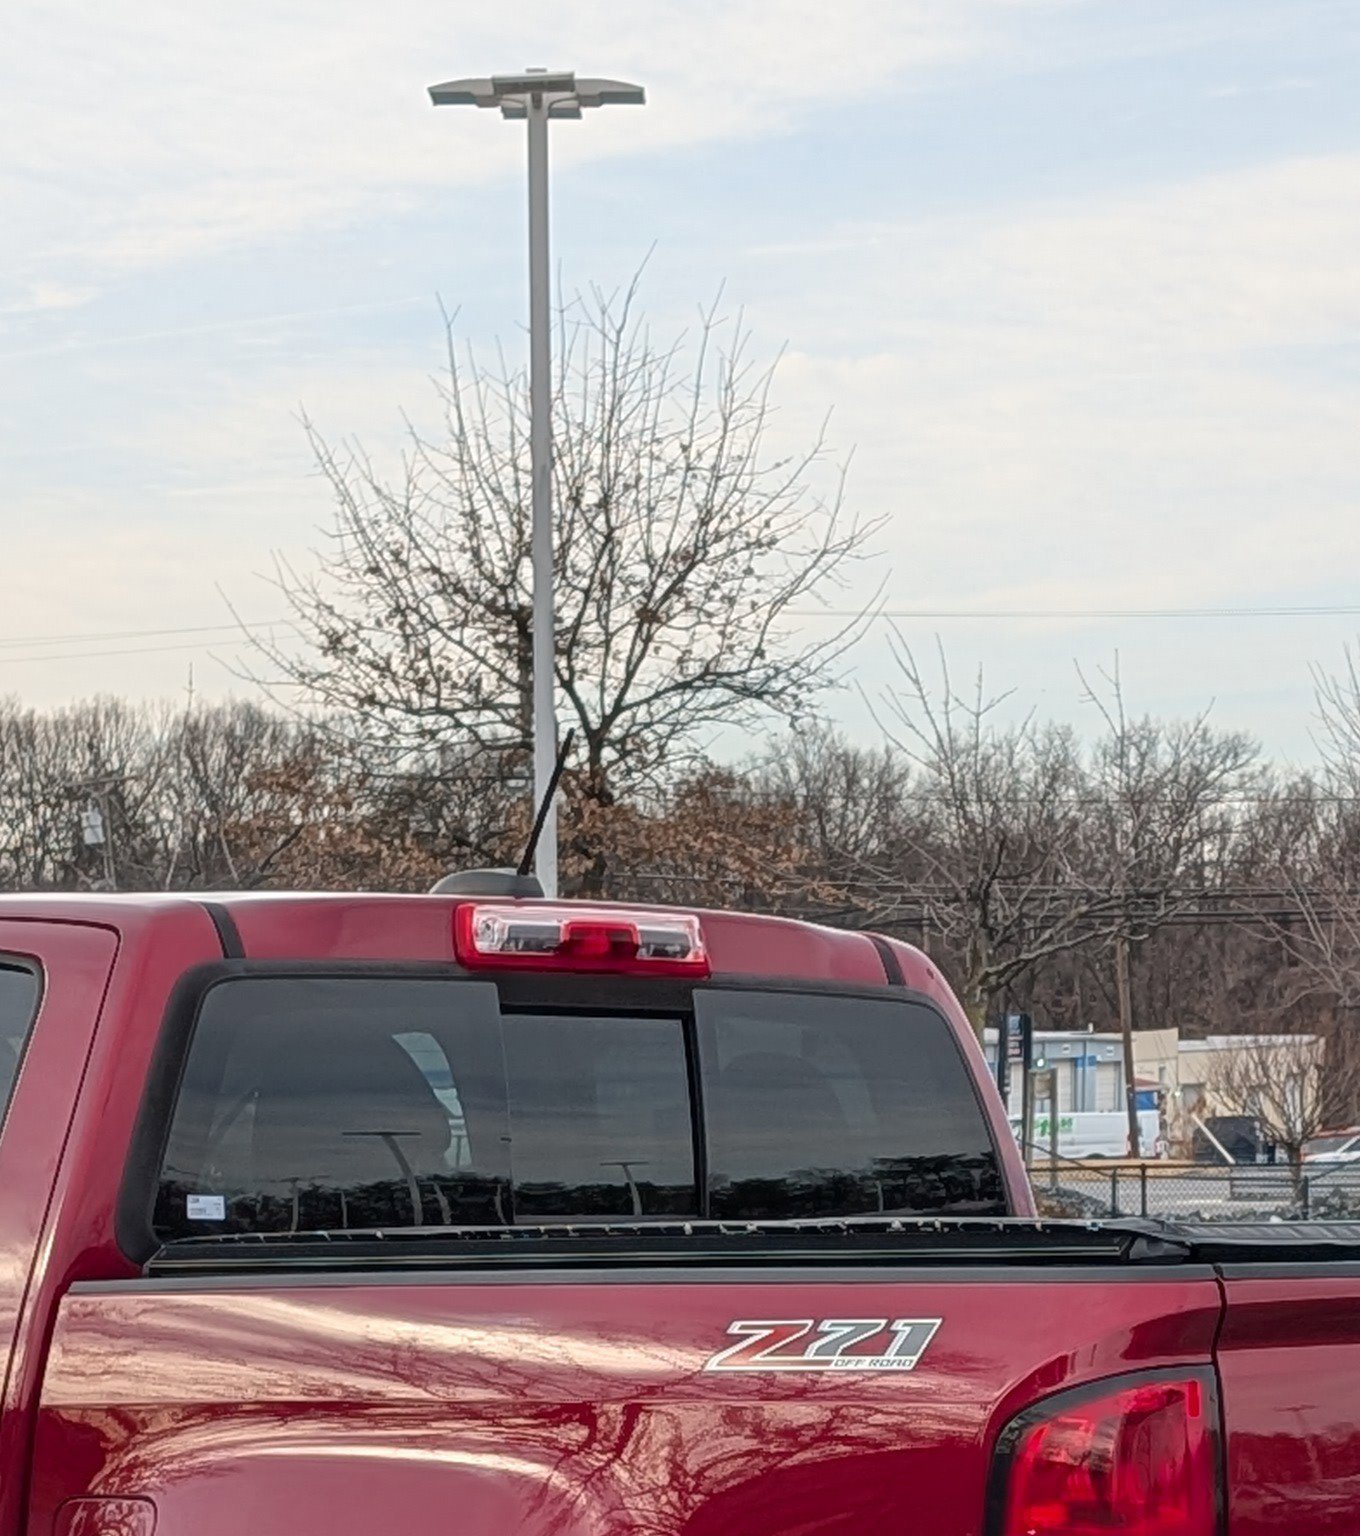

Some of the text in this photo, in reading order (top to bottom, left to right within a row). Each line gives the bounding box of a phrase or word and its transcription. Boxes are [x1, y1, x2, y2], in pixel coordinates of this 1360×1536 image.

[703, 1318, 943, 1371] Z71
[834, 1358, 914, 1367] OFF ROAD
